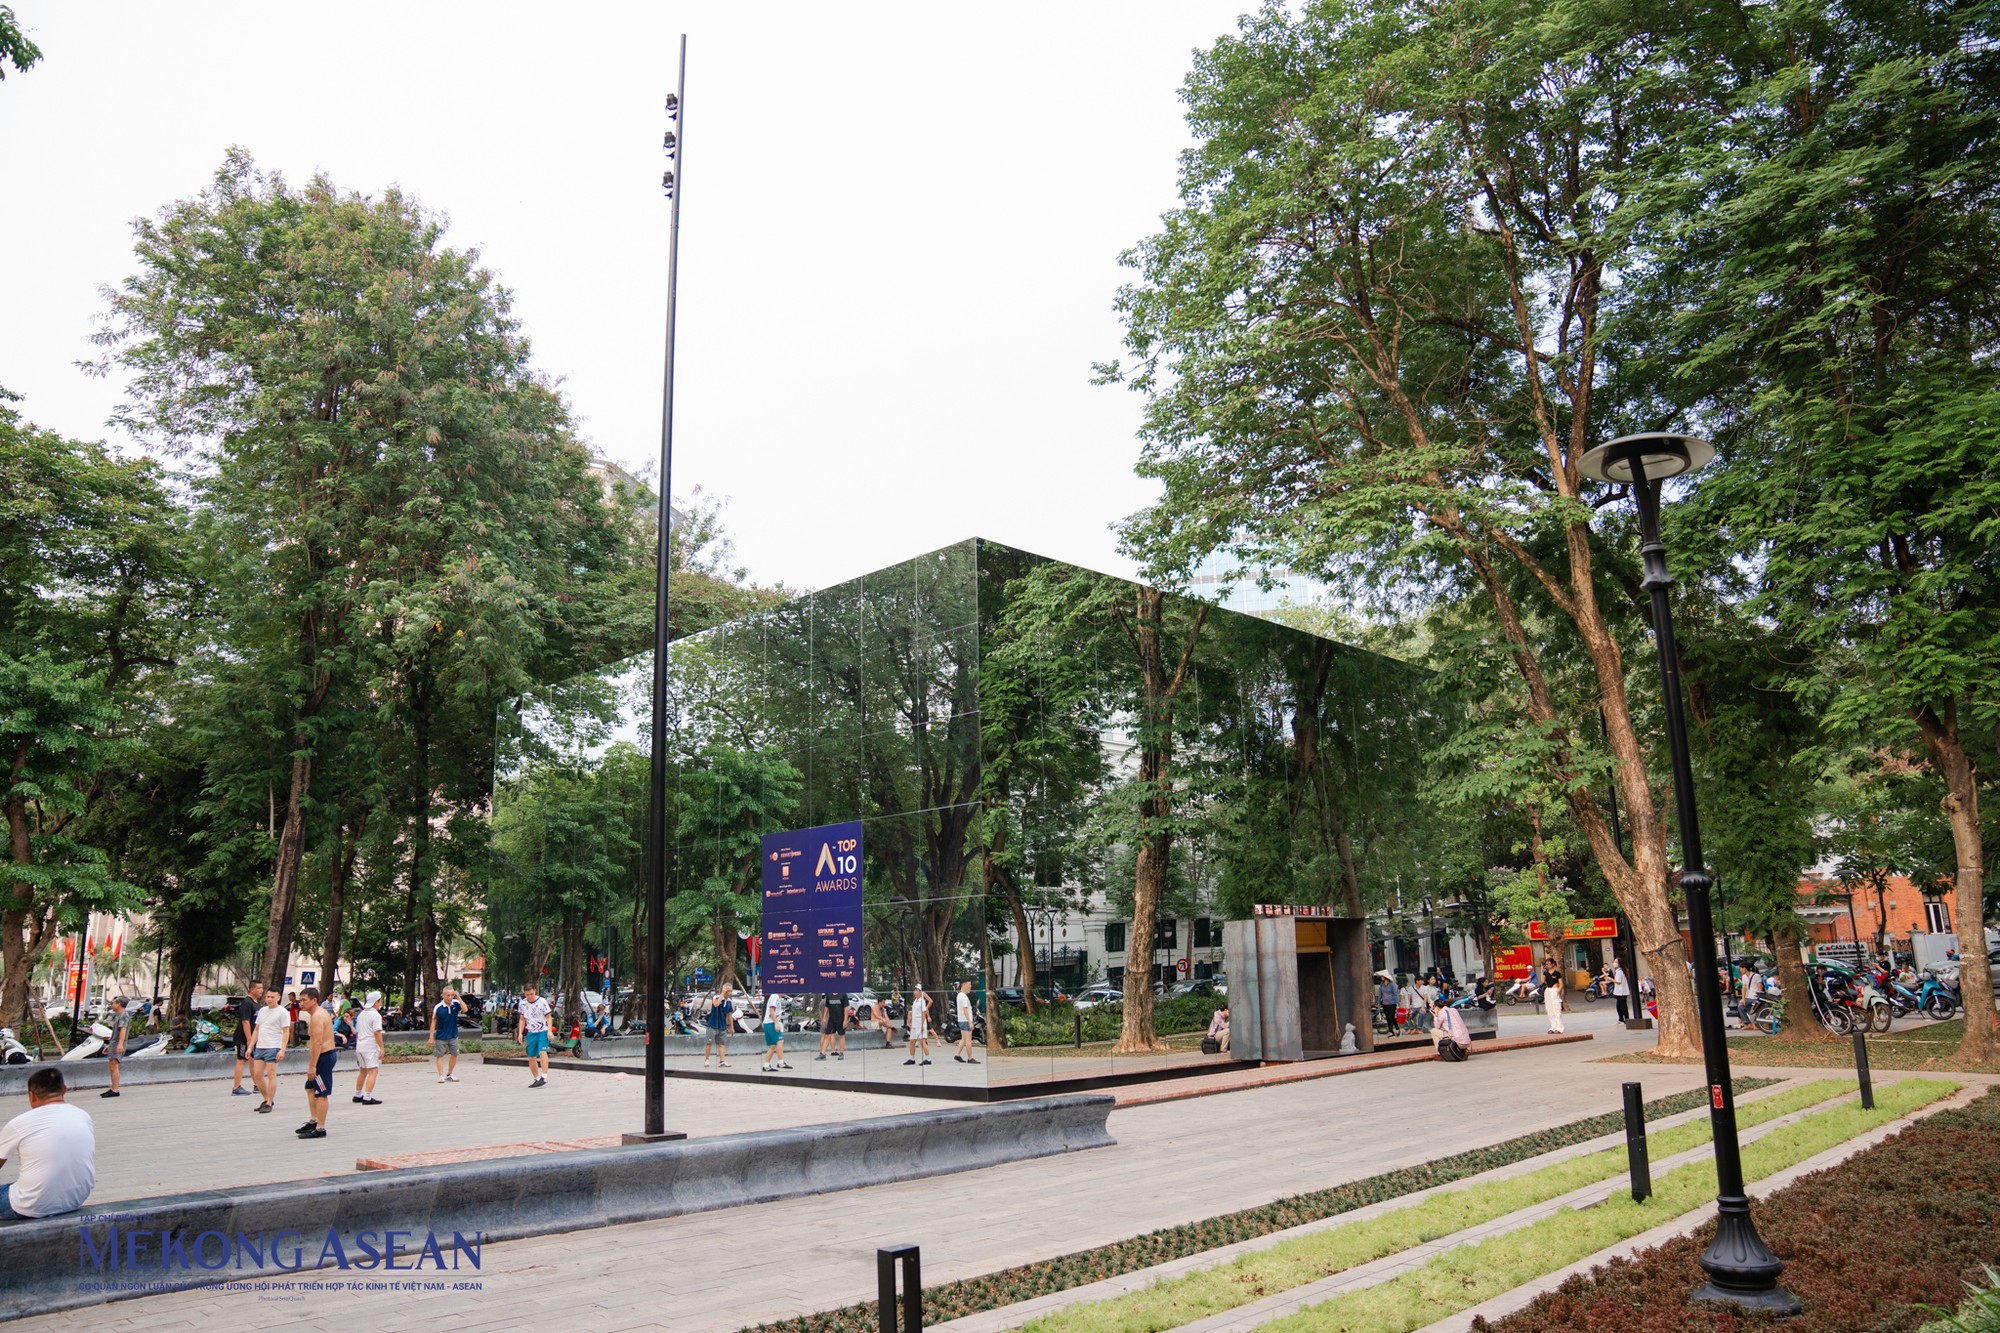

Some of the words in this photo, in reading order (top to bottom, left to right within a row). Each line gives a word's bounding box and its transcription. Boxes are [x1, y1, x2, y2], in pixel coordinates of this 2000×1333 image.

[837, 839, 857, 852] TOP
[837, 855, 857, 875] 10
[815, 876, 858, 893] AWARDS
